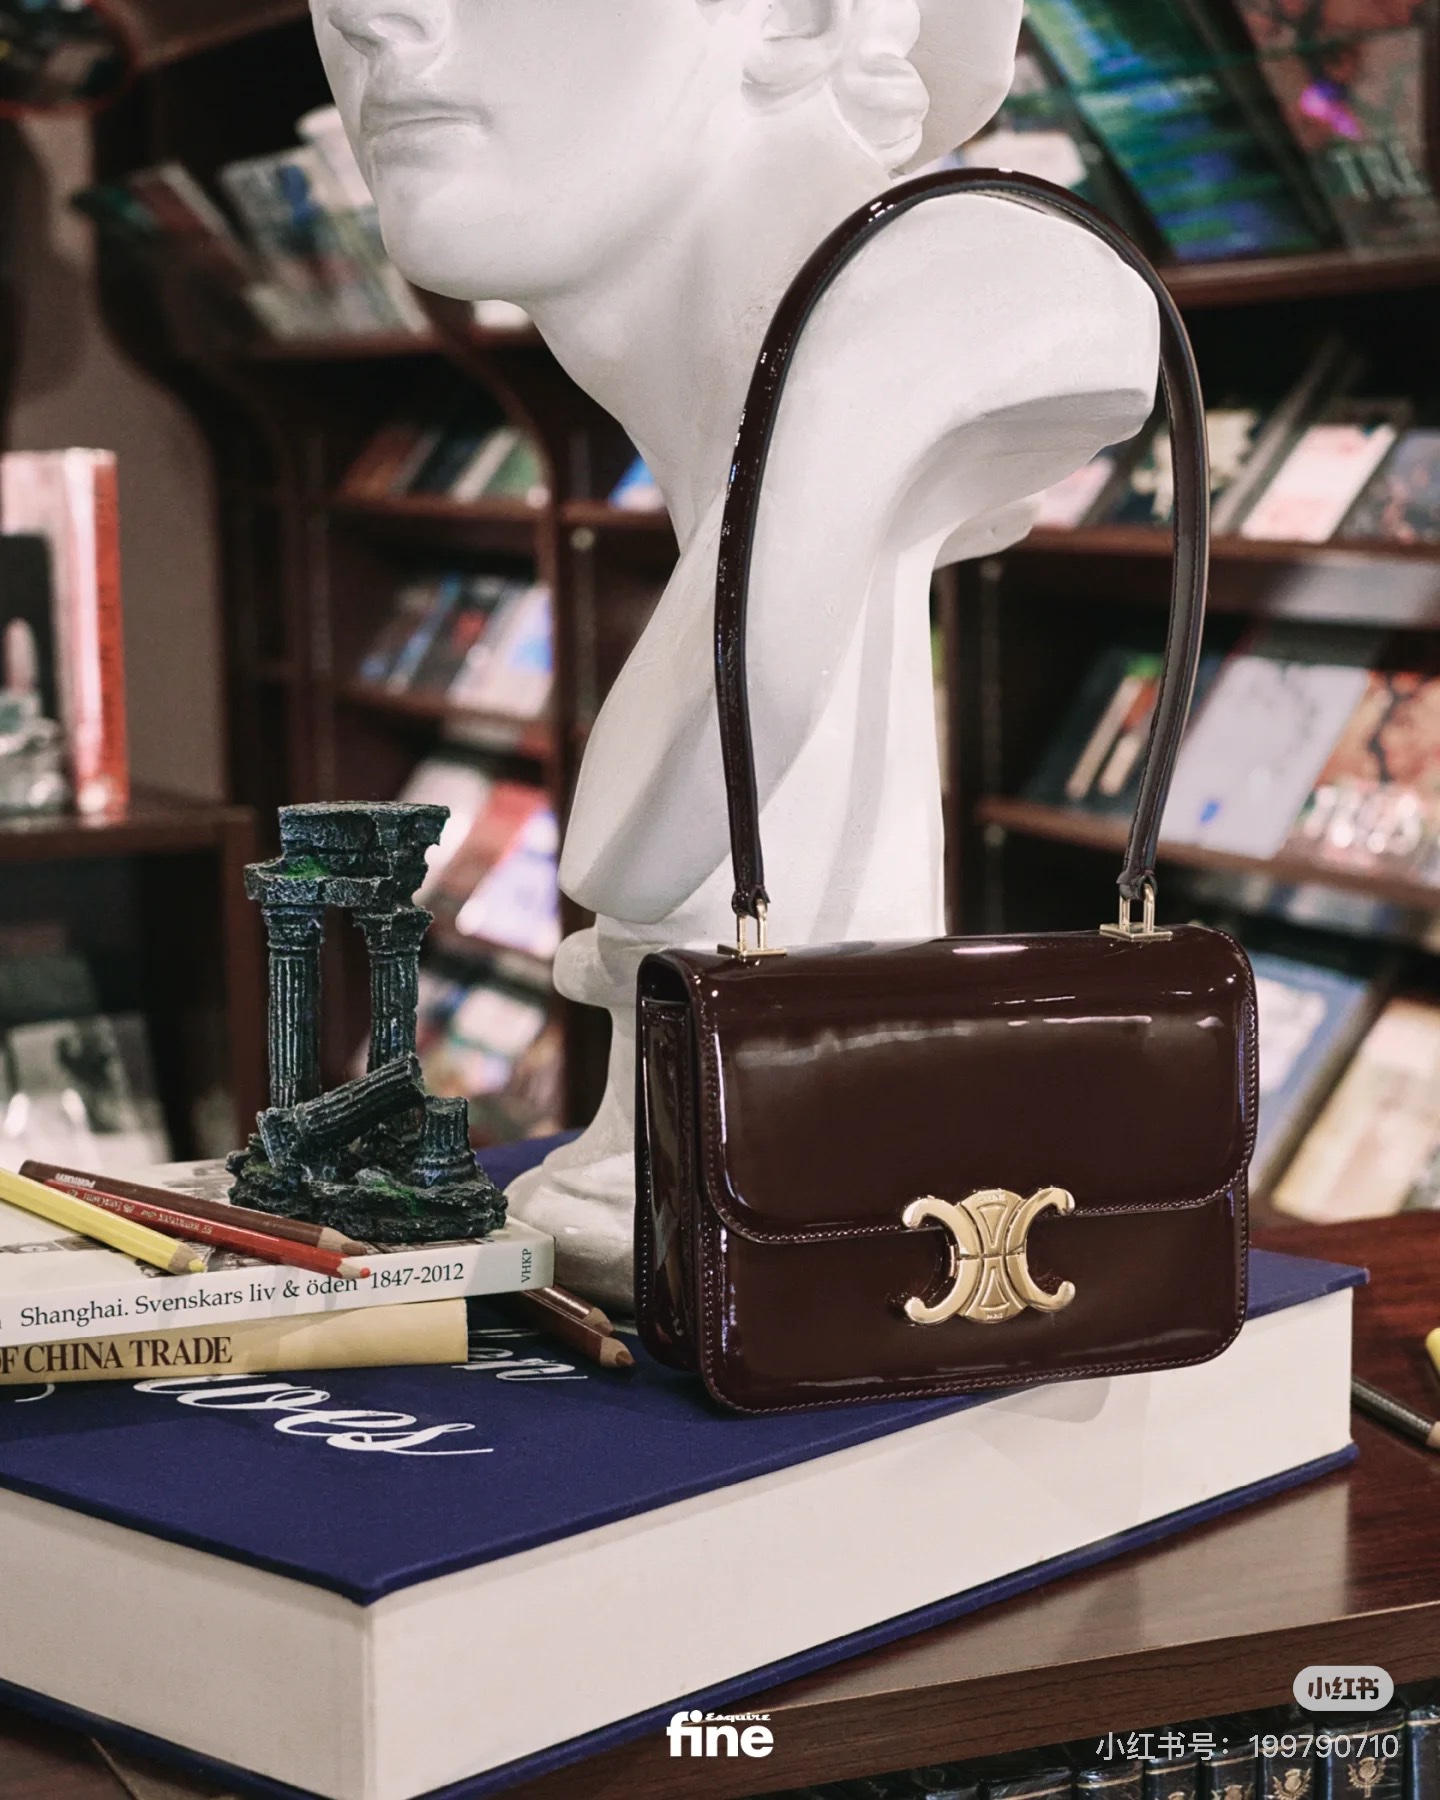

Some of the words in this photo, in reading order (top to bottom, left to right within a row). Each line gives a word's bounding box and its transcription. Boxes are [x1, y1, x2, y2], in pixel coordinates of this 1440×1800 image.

[521, 1248, 532, 1283] VHKP
[20, 1299, 129, 1328] Shanghai.
[135, 1289, 243, 1315] Svenskars
[250, 1284, 275, 1301] liv
[282, 1280, 300, 1297] &
[306, 1275, 358, 1296] öden
[370, 1263, 464, 1289] 1847-2012
[0, 1346, 19, 1374] F
[24, 1341, 124, 1373] CHINA
[130, 1336, 233, 1367] TRADE
